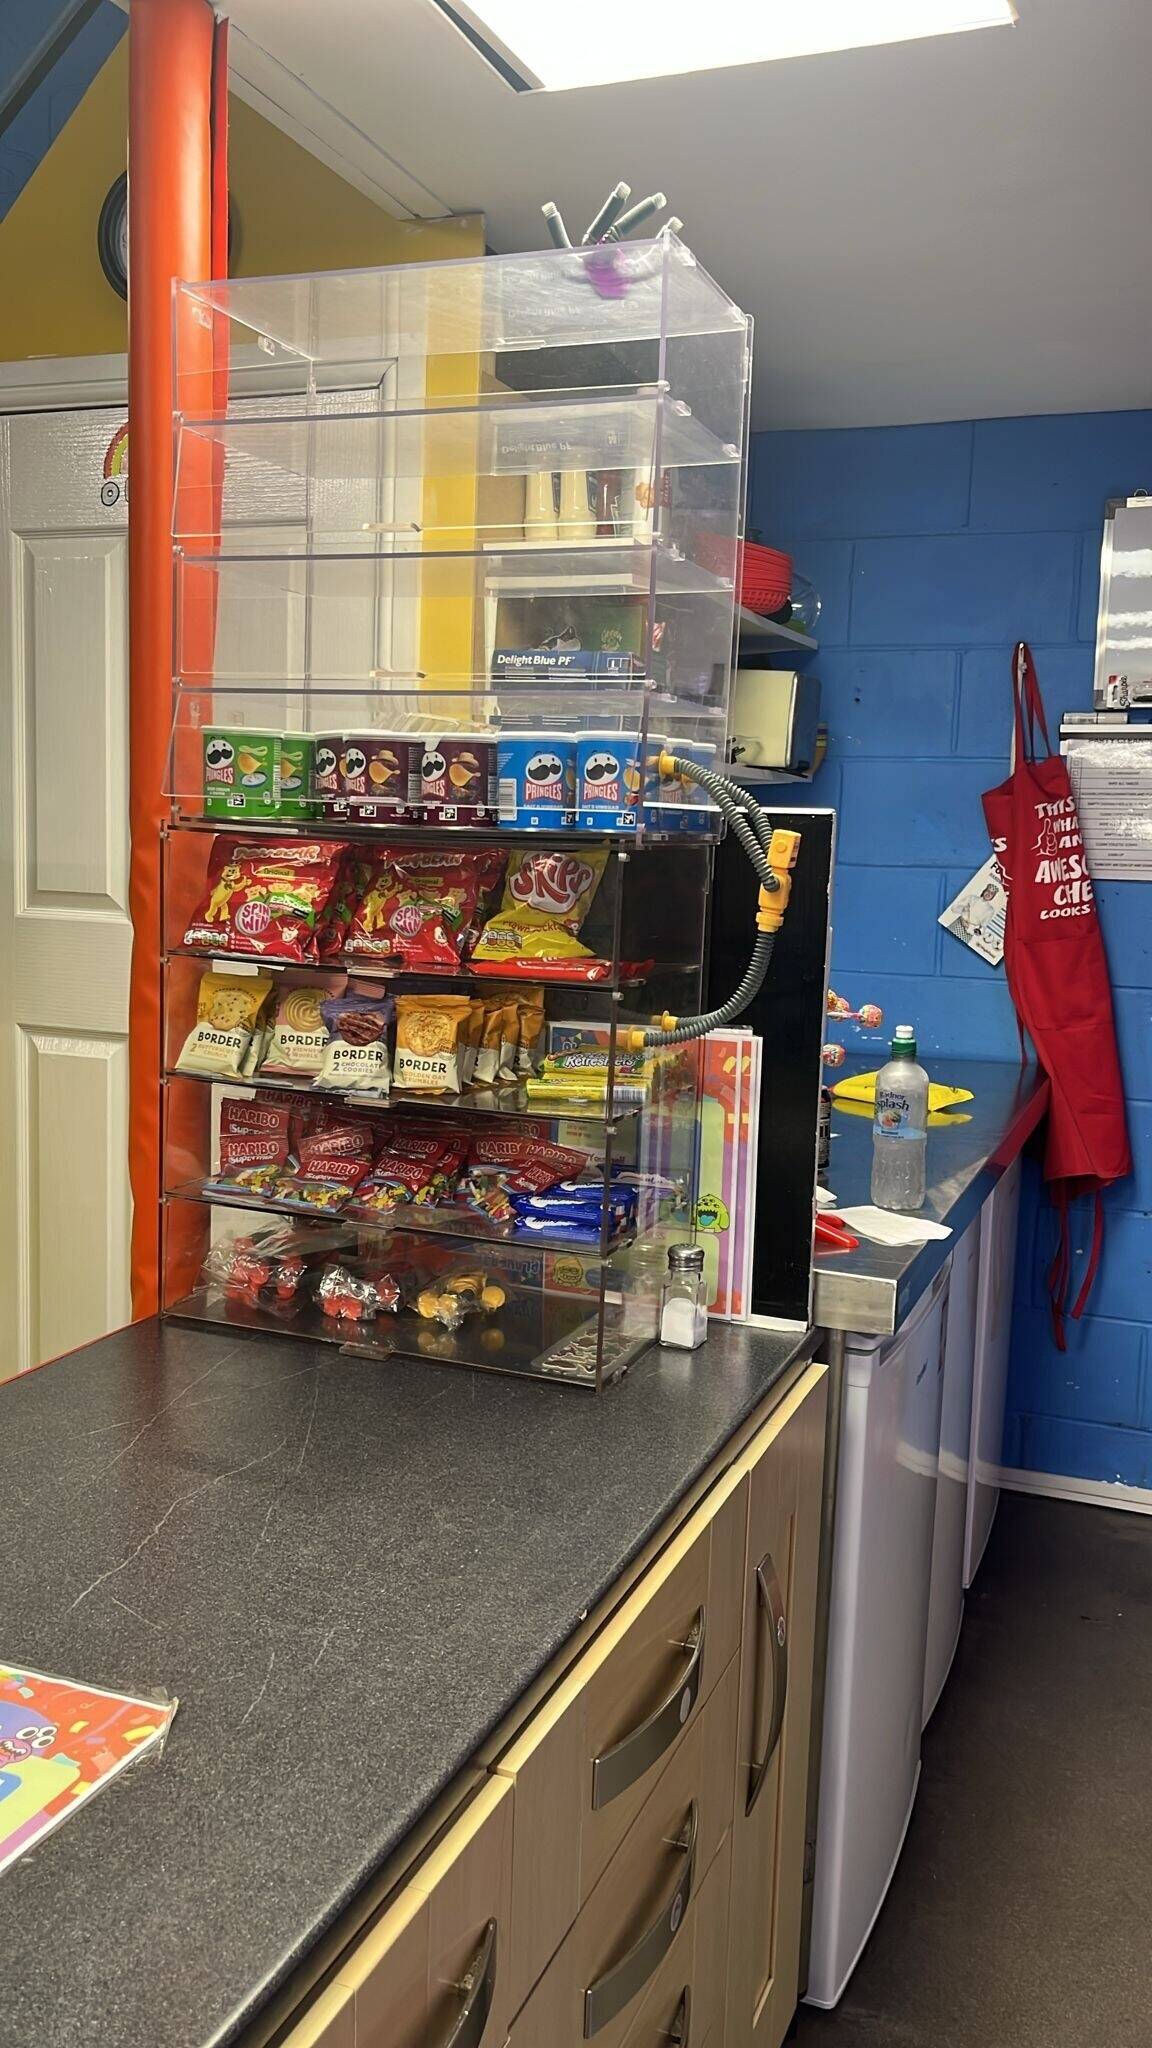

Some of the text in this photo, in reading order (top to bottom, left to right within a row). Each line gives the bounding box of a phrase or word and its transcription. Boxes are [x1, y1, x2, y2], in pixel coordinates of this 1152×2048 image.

[497, 654, 533, 667] Delight
[533, 655, 556, 665] Blue
[1119, 674, 1130, 708] Sharpie
[525, 782, 562, 801] PRINGLES
[583, 782, 618, 801] PRINGLES
[1034, 796, 1076, 819] THIS
[242, 903, 269, 918] SPIN
[396, 906, 421, 921] SPIN
[242, 915, 269, 932] WIN
[395, 919, 421, 937] WIN
[197, 1031, 242, 1048] BORDER
[190, 1043, 197, 1052] 2
[286, 1047, 292, 1057] 2
[333, 1049, 383, 1062] BORDER
[333, 1062, 340, 1071] 2
[399, 1058, 447, 1073] BORDER
[876, 1098, 910, 1111] splash
[228, 1105, 280, 1128] HARIBO
[228, 1141, 280, 1156] HARIBO
[477, 1141, 521, 1155] HARIB
[307, 1160, 360, 1175] HARIBO
[378, 1158, 424, 1180] HARIBO
